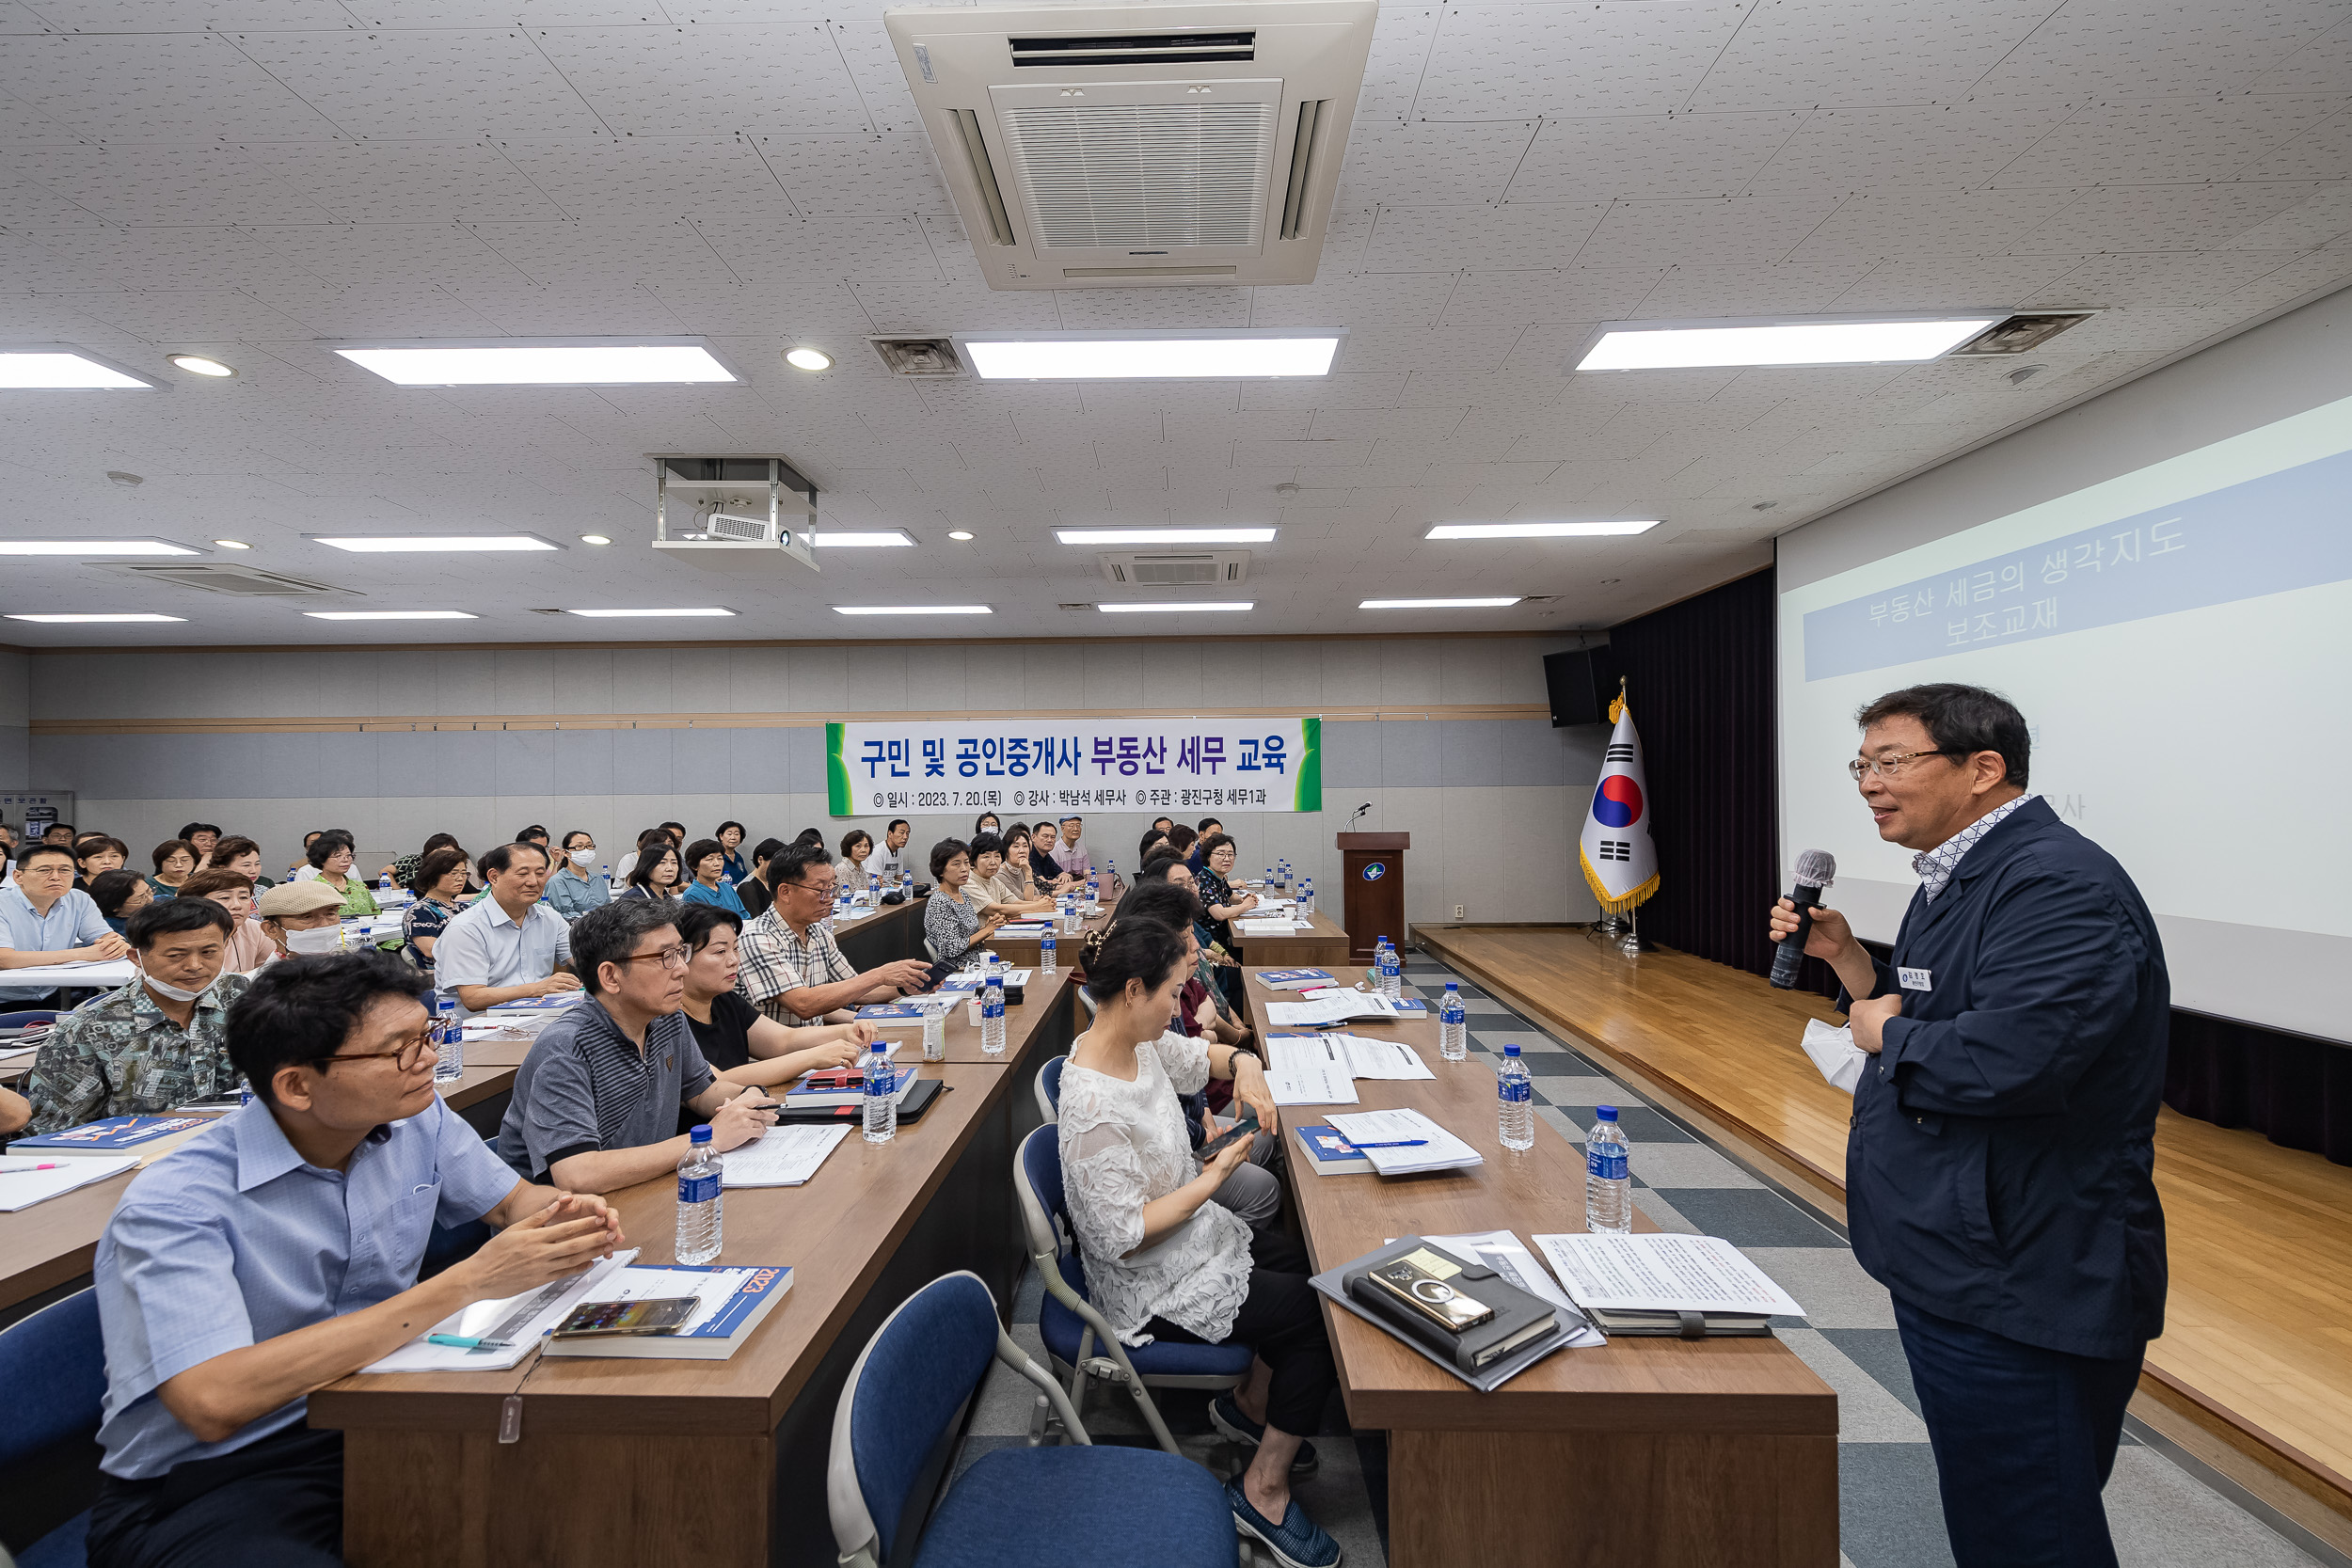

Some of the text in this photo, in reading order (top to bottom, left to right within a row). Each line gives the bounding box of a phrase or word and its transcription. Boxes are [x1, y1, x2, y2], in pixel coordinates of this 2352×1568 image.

[1867, 516, 2186, 628] 부동산 세금의 생각지도
[1946, 595, 2058, 647] 보조교재
[861, 735, 1287, 778] 구민 및 공인중개사 부동산 세무 교육
[887, 791, 908, 808] 일시
[918, 792, 949, 807] 2023.
[952, 792, 962, 807] 7.
[966, 790, 1002, 808] 20.(목)
[1028, 789, 1050, 807] 강사
[1059, 789, 1090, 807] 박남석
[1093, 788, 1126, 806] 세무사
[1150, 788, 1171, 806] 주관
[1181, 788, 1224, 806] 광진구청
[1226, 788, 1266, 806] 세무1과
[742, 1268, 780, 1293] 2023
